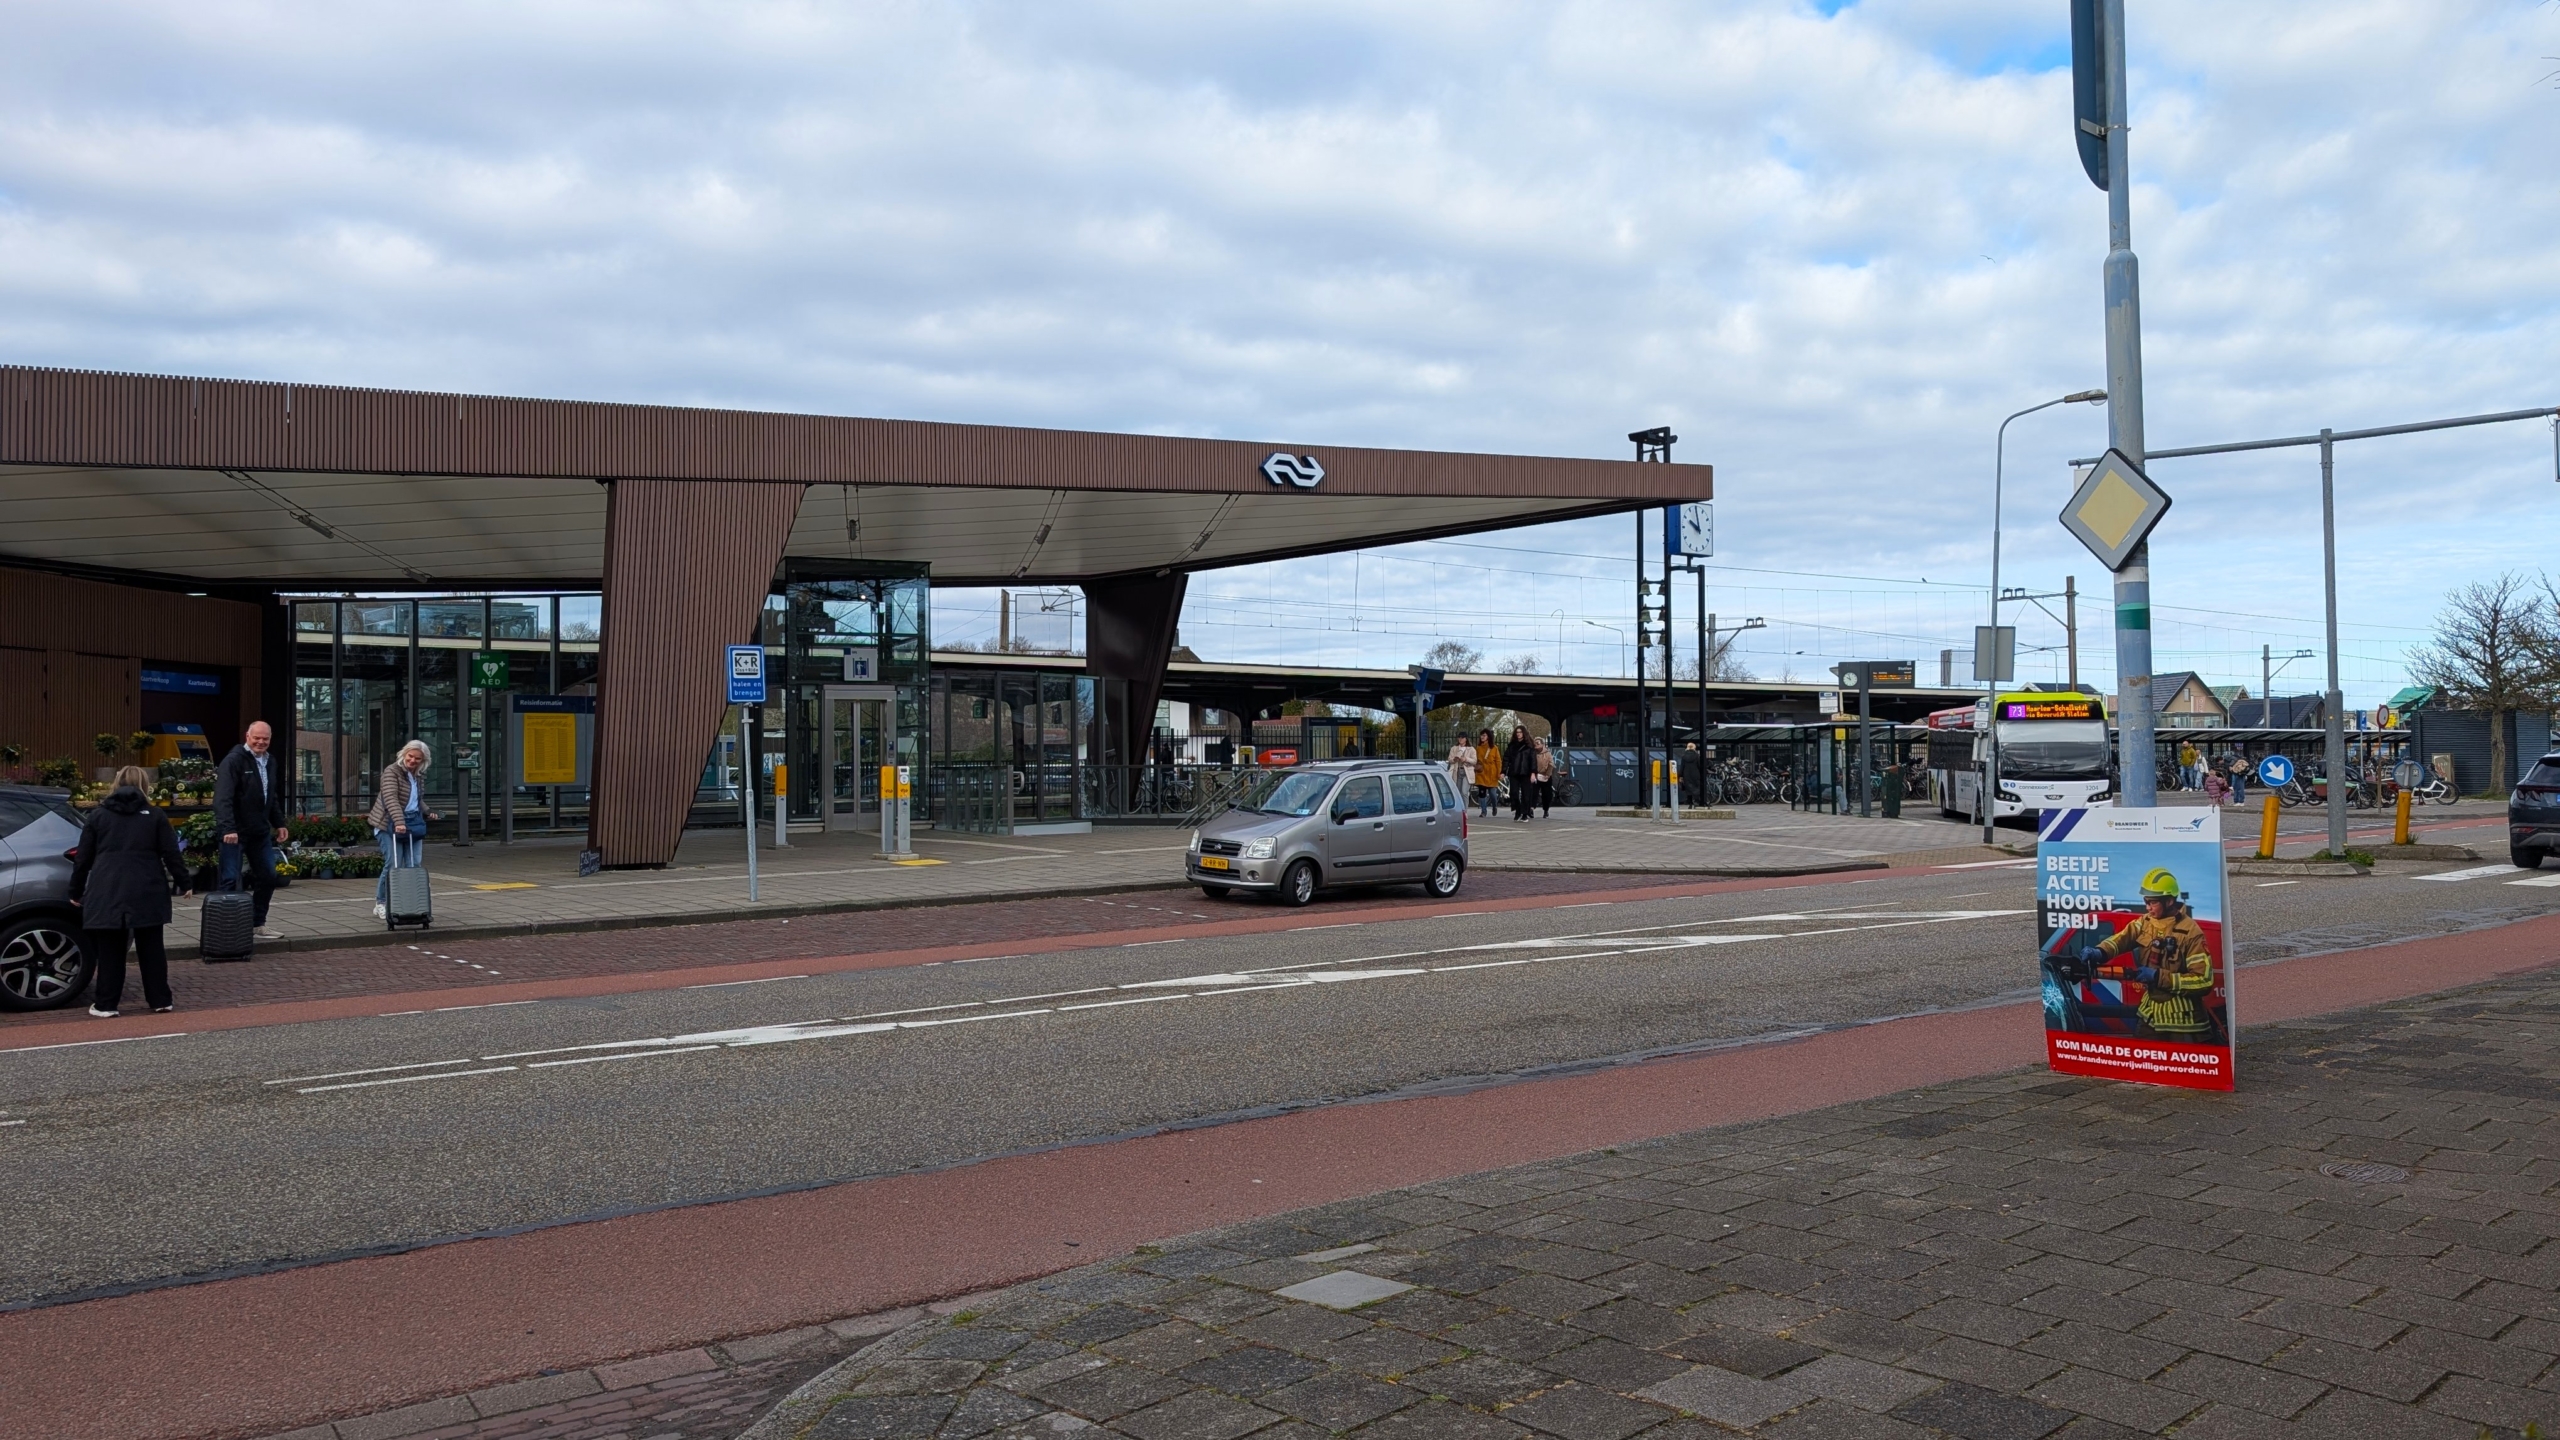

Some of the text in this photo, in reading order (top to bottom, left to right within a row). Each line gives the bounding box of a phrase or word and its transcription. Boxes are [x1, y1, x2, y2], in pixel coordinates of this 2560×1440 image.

[734, 656, 758, 667] K+R
[2012, 706, 2023, 717] 73
[2046, 856, 2109, 873] BEETJE
[2046, 874, 2100, 891] ACTIE
[2046, 893, 2115, 911] HOORT
[2047, 912, 2099, 930] ERBIJ
[2055, 1039, 2219, 1065] KOM NAAR DE OPEN AVOND
[2056, 1052, 2219, 1075] www.brandweervrijwilligerworden.nl
